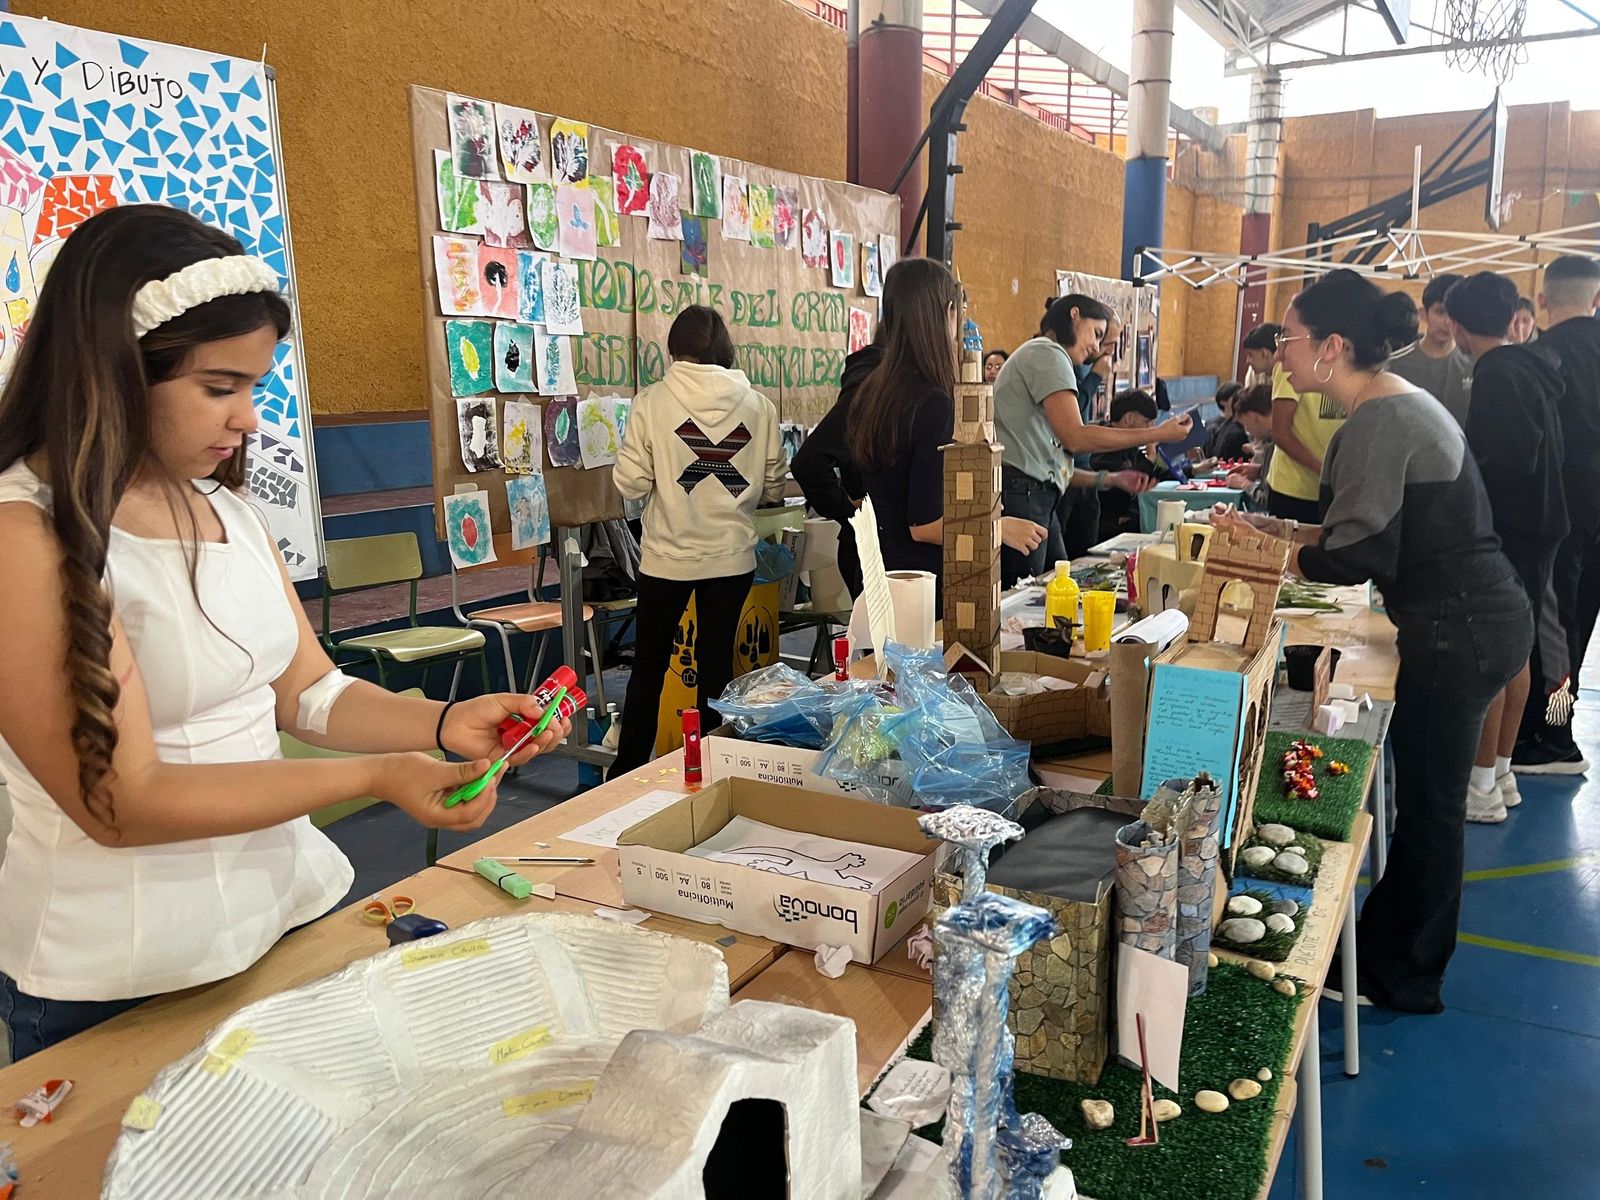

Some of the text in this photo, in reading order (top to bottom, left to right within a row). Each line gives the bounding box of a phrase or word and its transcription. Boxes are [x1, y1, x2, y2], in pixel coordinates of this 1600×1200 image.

[32, 57, 49, 85] Y
[730, 289, 784, 328] DEL
[757, 773, 804, 787] MultiOficina
[636, 867, 643, 876] 5
[655, 871, 669, 882] 500
[679, 876, 690, 886] A4
[701, 881, 712, 890] 80
[678, 889, 734, 910] MultiOficina
[779, 894, 858, 934] bonova
